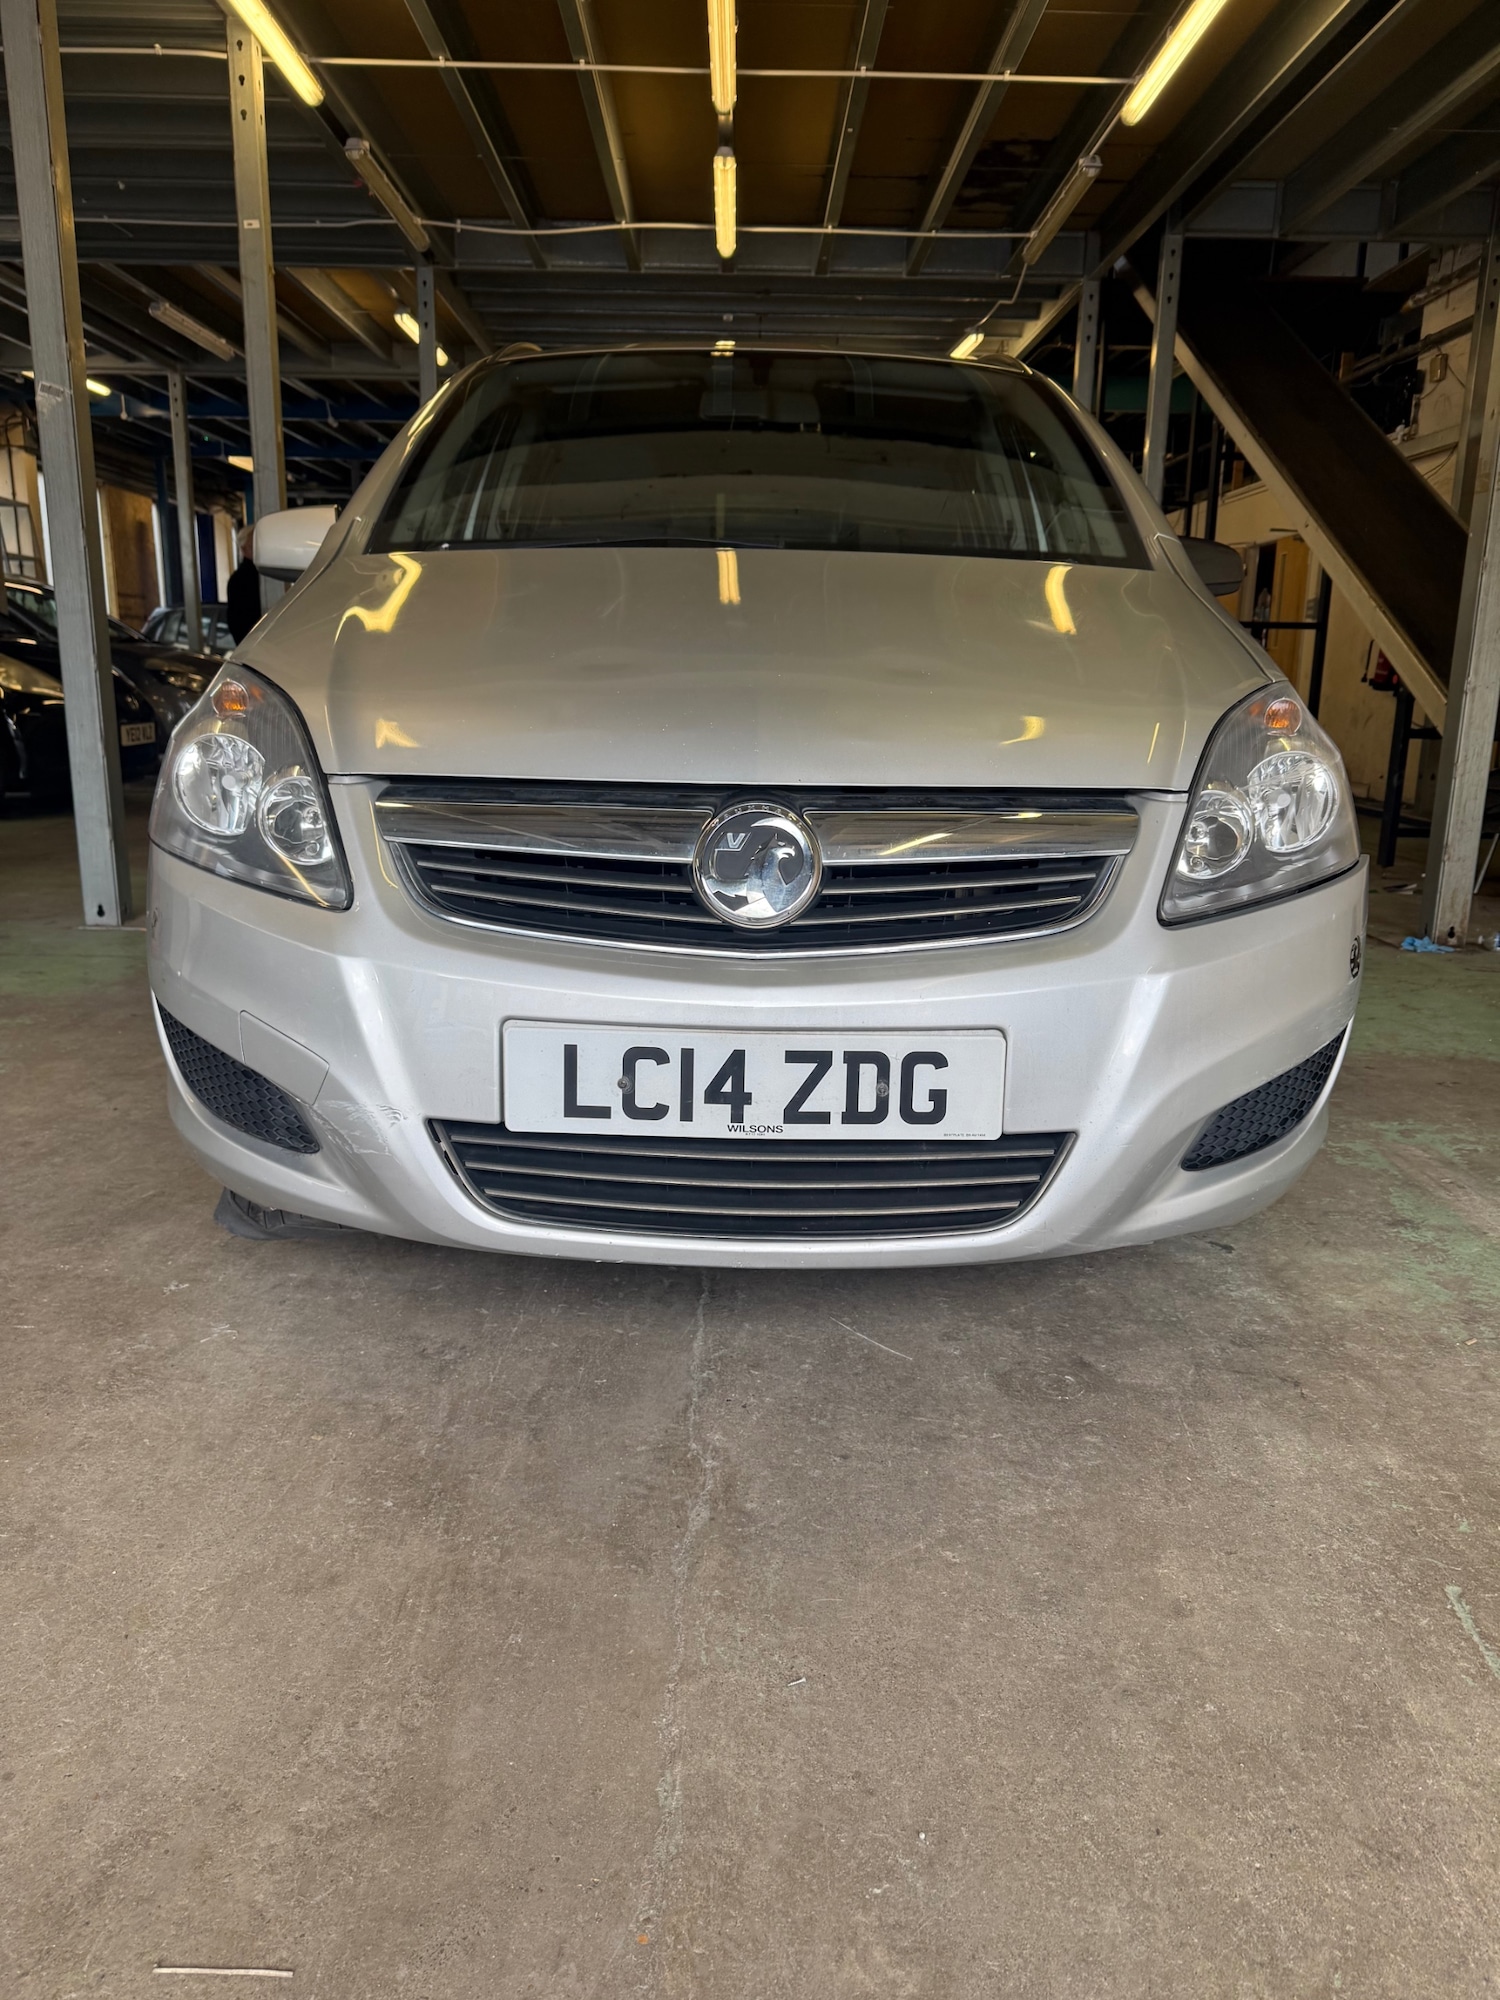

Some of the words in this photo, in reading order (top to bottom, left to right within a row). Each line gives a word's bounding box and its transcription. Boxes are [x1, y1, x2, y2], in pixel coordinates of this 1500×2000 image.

[563, 1043, 753, 1125] LC14
[783, 1050, 949, 1126] ZDG
[727, 1124, 784, 1134] WILSONS
